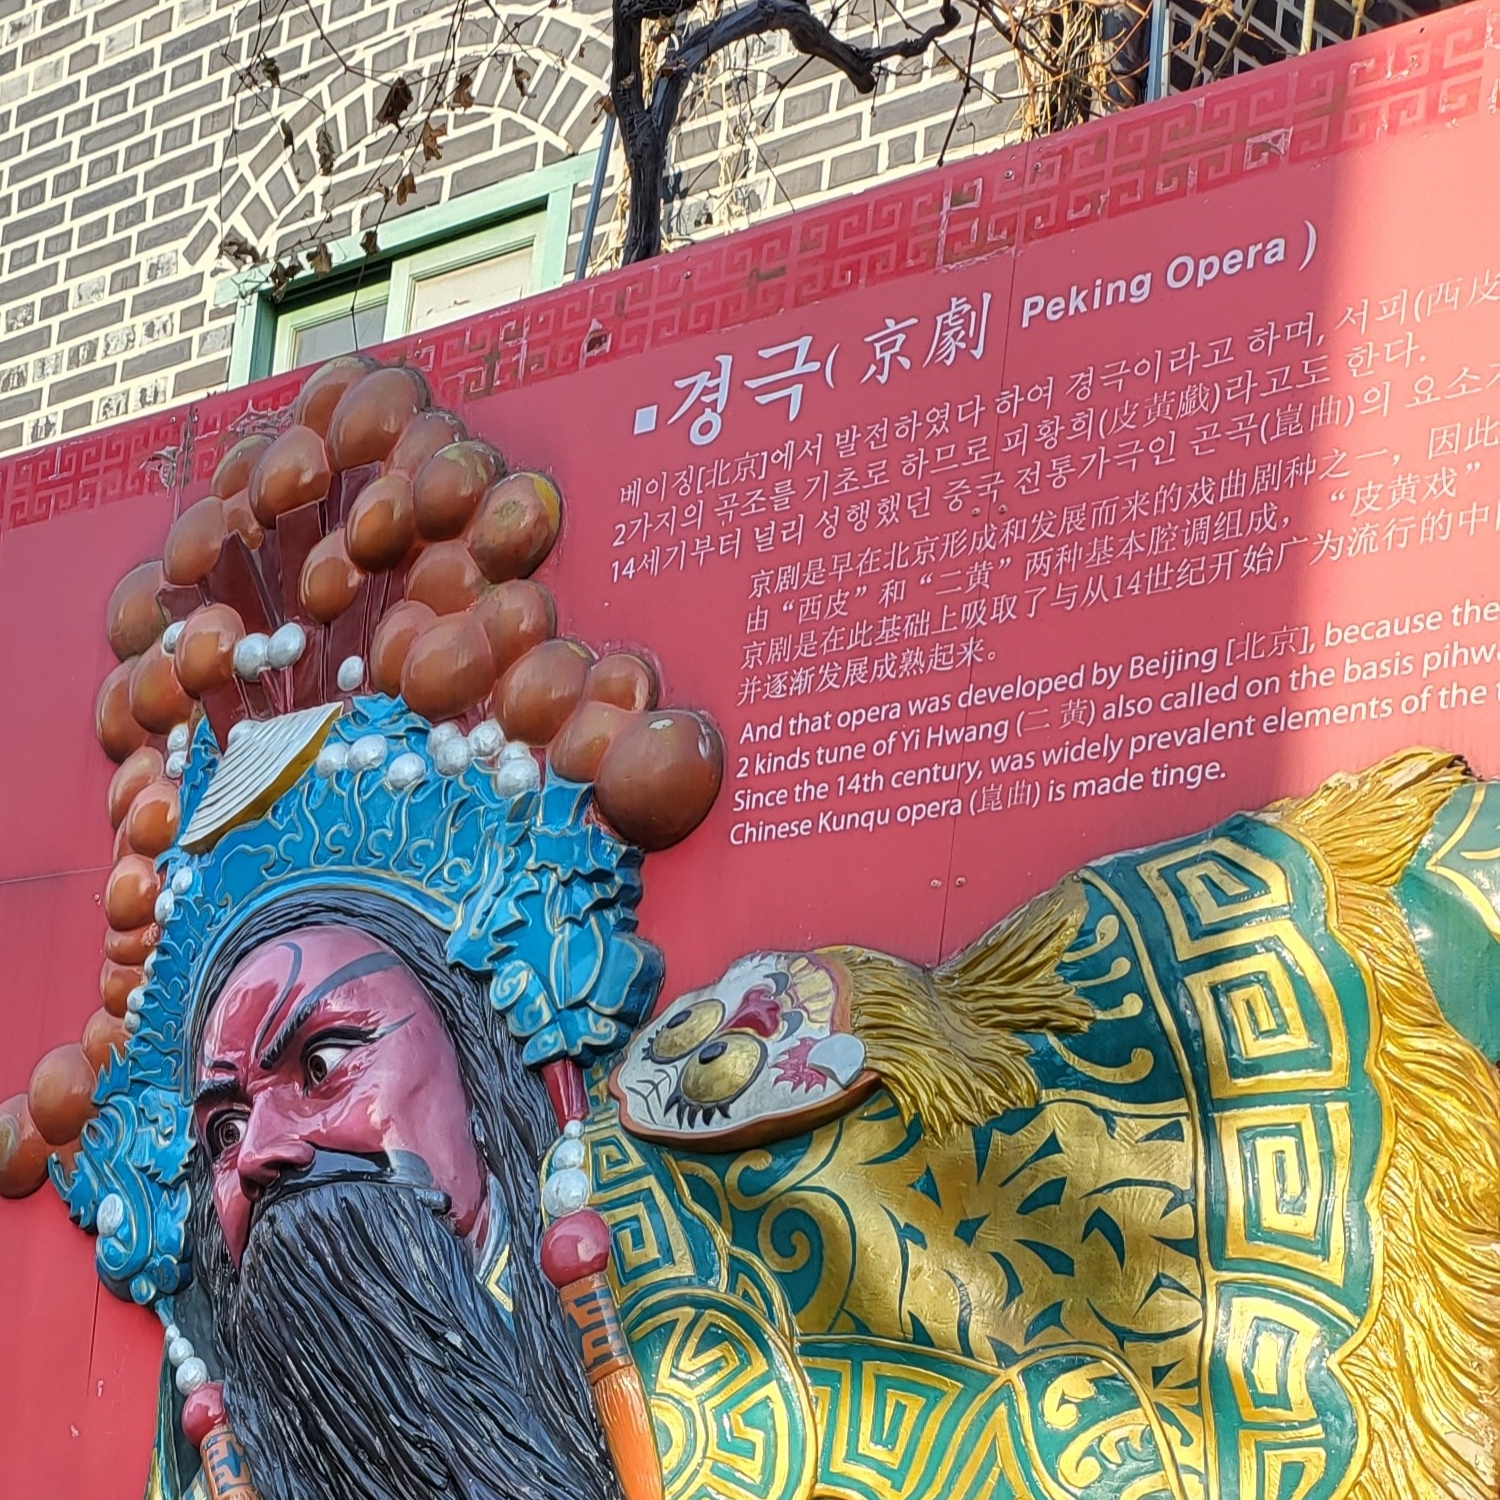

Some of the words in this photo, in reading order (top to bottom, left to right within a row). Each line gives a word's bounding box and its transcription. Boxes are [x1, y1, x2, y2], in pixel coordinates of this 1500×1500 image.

[1022, 272, 1151, 328] Peking
[1167, 238, 1285, 288] Opera
[613, 499, 703, 547] 2가지의
[714, 479, 796, 527] 곡조를
[803, 459, 890, 502] 기초로
[901, 436, 991, 481] 하므로
[1346, 332, 1425, 377] 한다.
[621, 433, 822, 508] 베이징[北京]에서
[835, 395, 985, 458] 발전하였다
[995, 376, 1053, 419] 하여
[1065, 337, 1234, 400] 경극이라고
[1247, 312, 1324, 357] 하며,
[612, 528, 741, 583] 14세기부터
[754, 514, 804, 552] 널리
[814, 486, 930, 539] 성행했던
[942, 471, 1003, 510] 중국
[1013, 430, 1175, 495] 전통가극인
[736, 757, 749, 778] 2
[755, 746, 810, 776] kinds
[816, 743, 866, 765] tune
[873, 731, 898, 756] of
[901, 728, 920, 752] Yi
[926, 719, 1009, 753] Hwang
[1103, 694, 1152, 721] also
[1160, 675, 1238, 711] called
[1246, 676, 1280, 697] on
[1289, 664, 1335, 691] the
[1344, 651, 1414, 684] basis
[740, 716, 783, 745] And
[788, 711, 832, 736] that
[837, 702, 900, 732] opera
[908, 694, 951, 716] was
[958, 664, 1084, 708] developed
[1091, 662, 1123, 690] by
[1129, 648, 1217, 679] Beijing
[1324, 612, 1442, 647] because
[1451, 599, 1500, 627] the
[730, 819, 812, 845] Chinese
[818, 808, 890, 833] Kunqu
[897, 798, 962, 826] opera
[1048, 779, 1065, 802] is
[1073, 767, 1144, 798] made
[1151, 762, 1225, 789] tinge.
[733, 789, 788, 812] Since
[794, 779, 829, 802] the
[837, 769, 884, 796] 14th
[891, 760, 983, 788] century,
[991, 751, 1035, 774] was
[1042, 733, 1123, 766] widely
[1129, 715, 1256, 760] prevalent
[1263, 697, 1392, 733] elements
[1401, 688, 1438, 714] of
[1439, 682, 1488, 709] the
